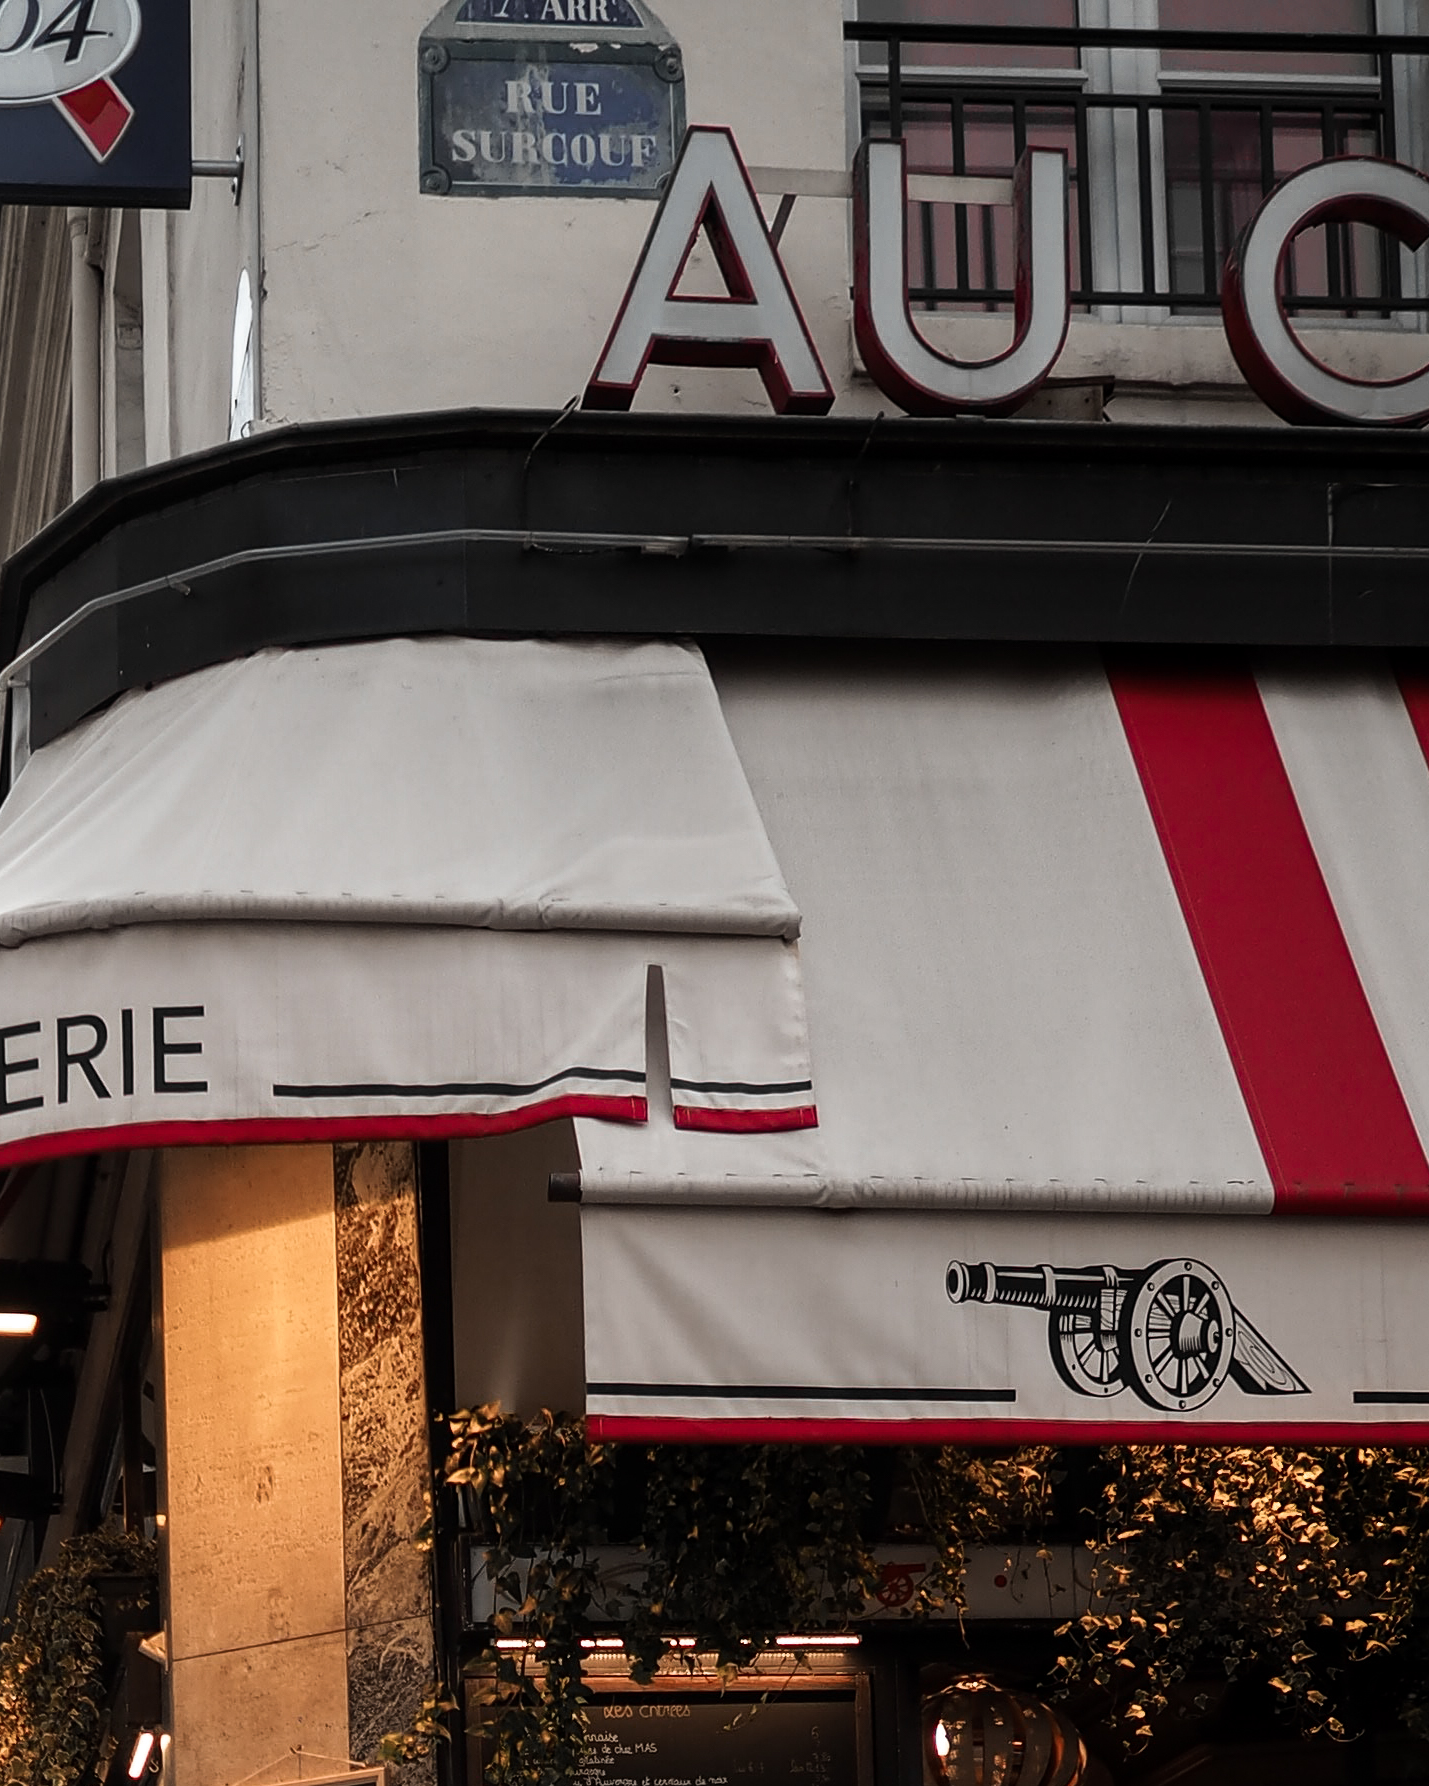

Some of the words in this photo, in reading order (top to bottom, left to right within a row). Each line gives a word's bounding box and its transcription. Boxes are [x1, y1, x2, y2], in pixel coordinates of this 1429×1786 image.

[504, 80, 602, 116] RUE
[451, 130, 657, 168] SURCOUF
[582, 125, 1069, 417] AU
[635, 1742, 658, 1754] MAS
